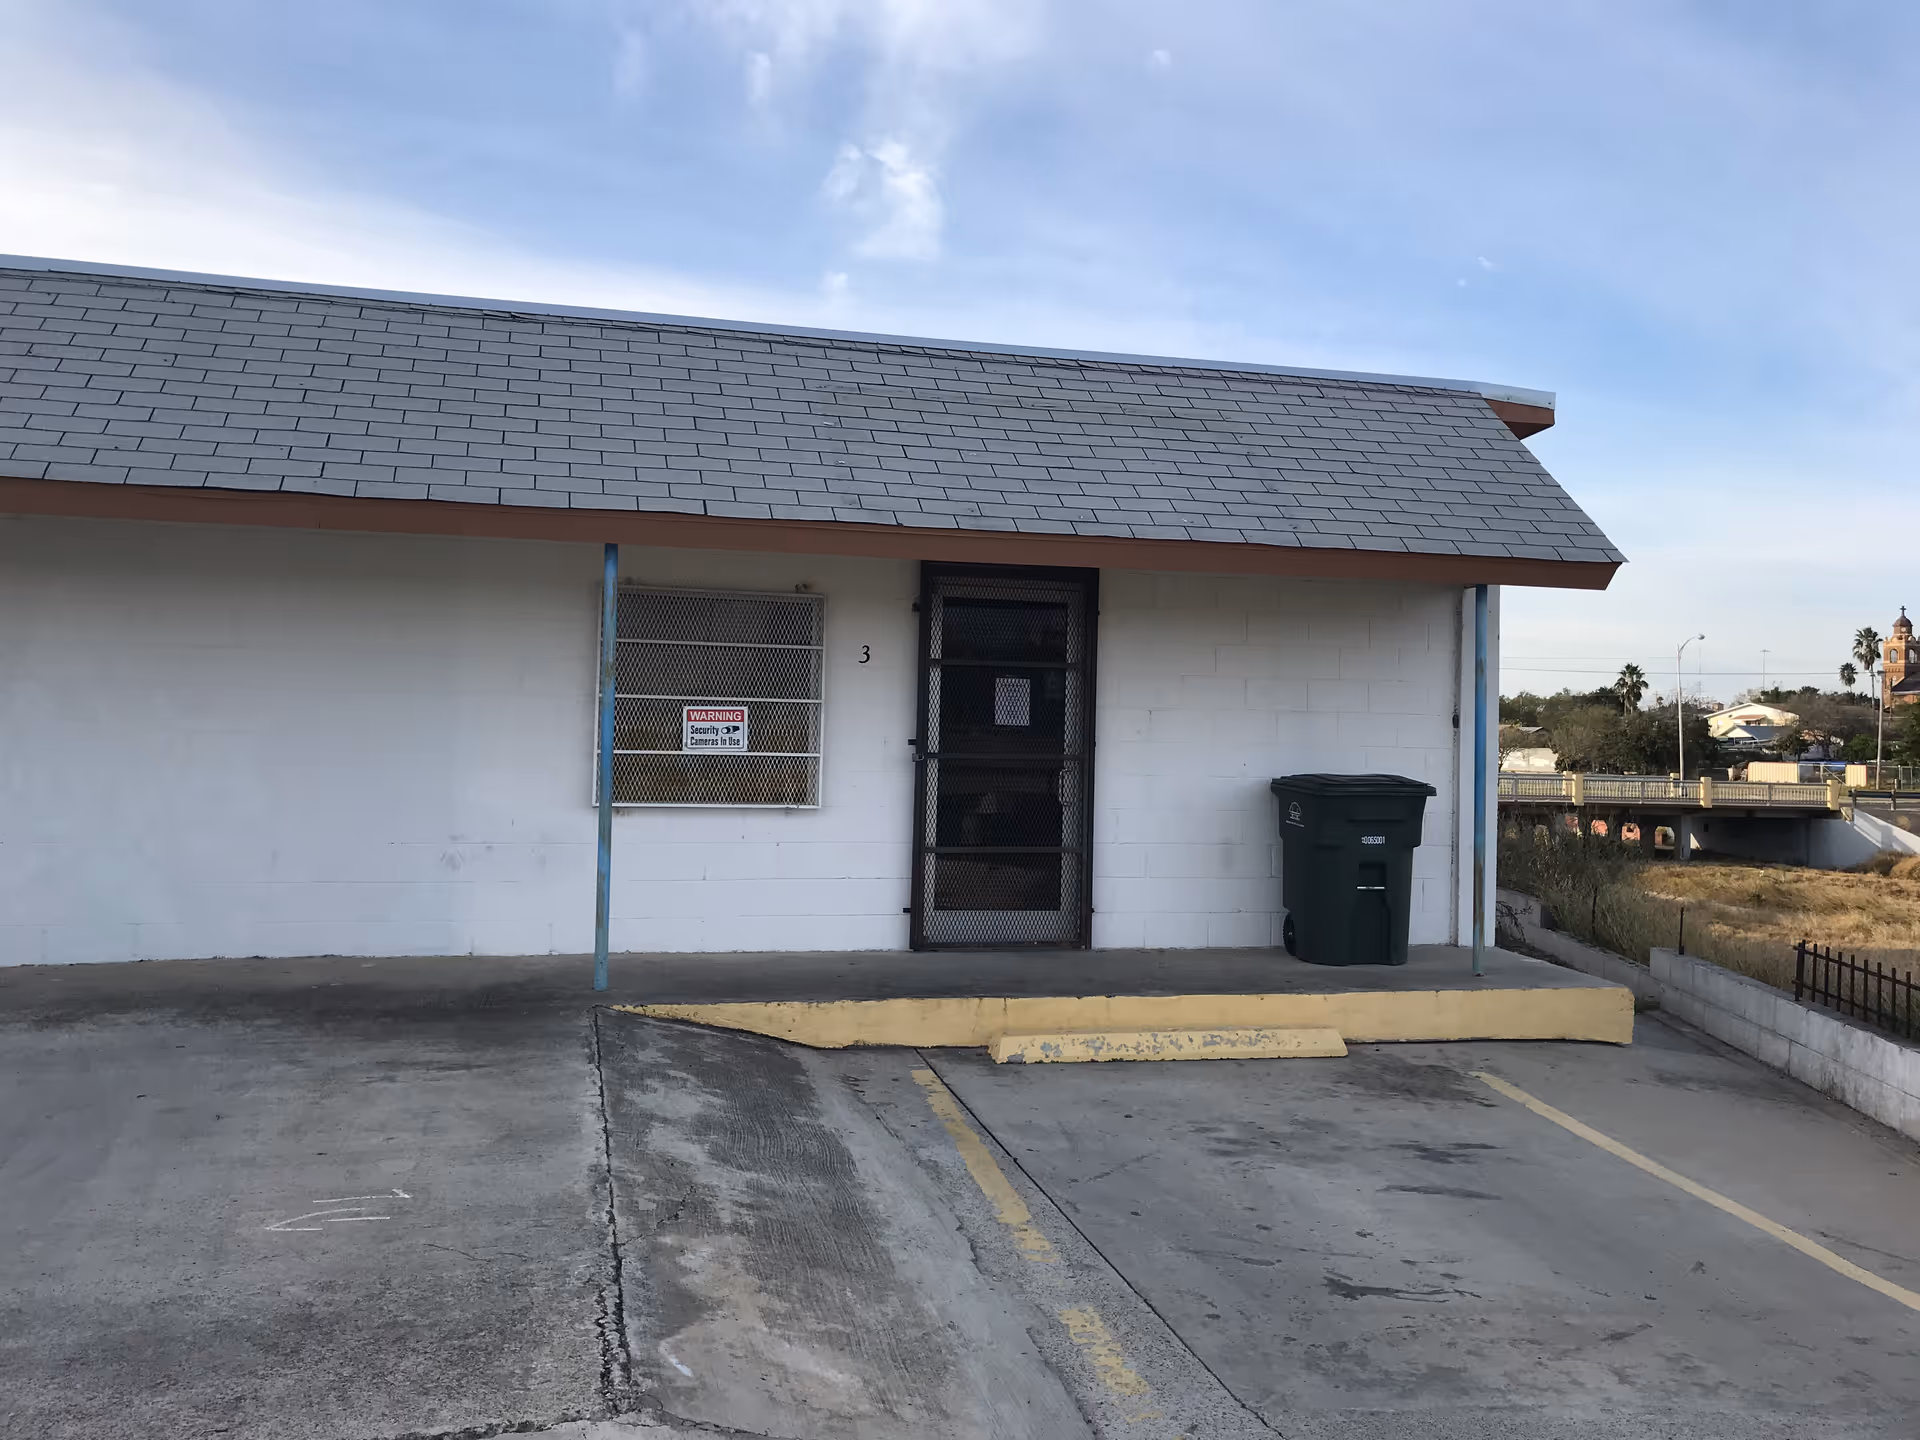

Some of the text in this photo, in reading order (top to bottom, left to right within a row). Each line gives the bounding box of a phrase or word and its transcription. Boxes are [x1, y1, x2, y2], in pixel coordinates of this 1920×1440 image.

[858, 644, 870, 664] 3
[690, 711, 742, 721] WARNING
[690, 725, 719, 736] Security
[690, 736, 741, 746] Cameras In Use
